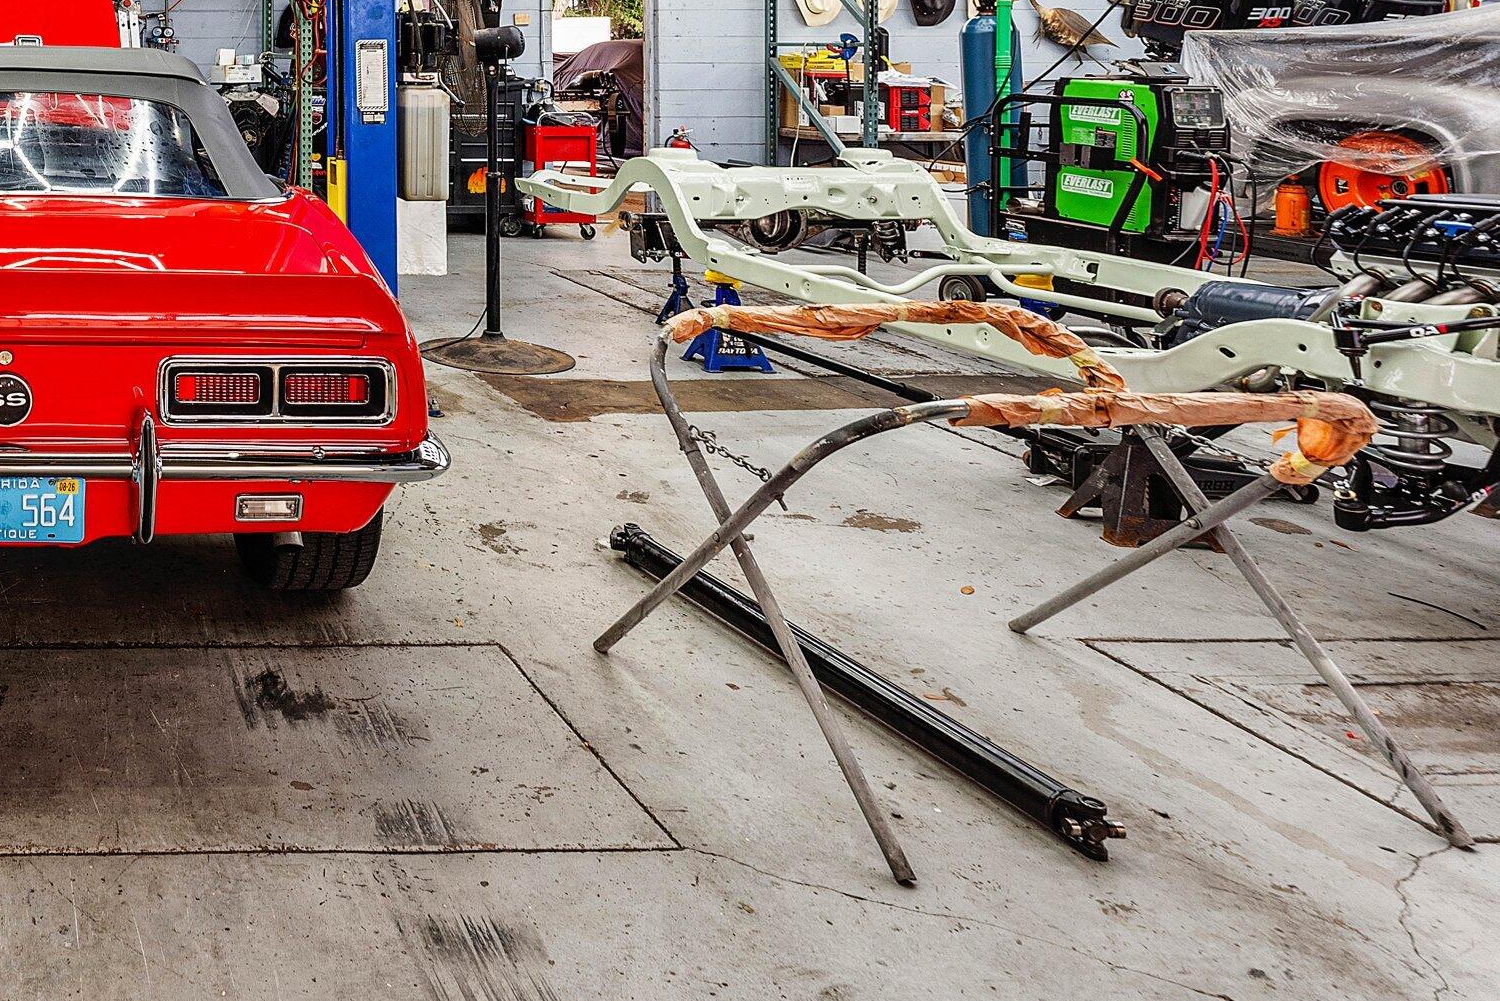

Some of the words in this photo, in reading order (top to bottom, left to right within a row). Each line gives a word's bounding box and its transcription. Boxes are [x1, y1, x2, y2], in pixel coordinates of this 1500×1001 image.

[1133, 3, 1222, 29] 300
[1247, 7, 1292, 20] 300
[1071, 104, 1119, 119] EVERLAST
[1063, 174, 1111, 192] EVERLAST
[717, 347, 760, 355] DAYTOA
[58, 482, 76, 492] 08-26
[22, 493, 76, 528] 564
